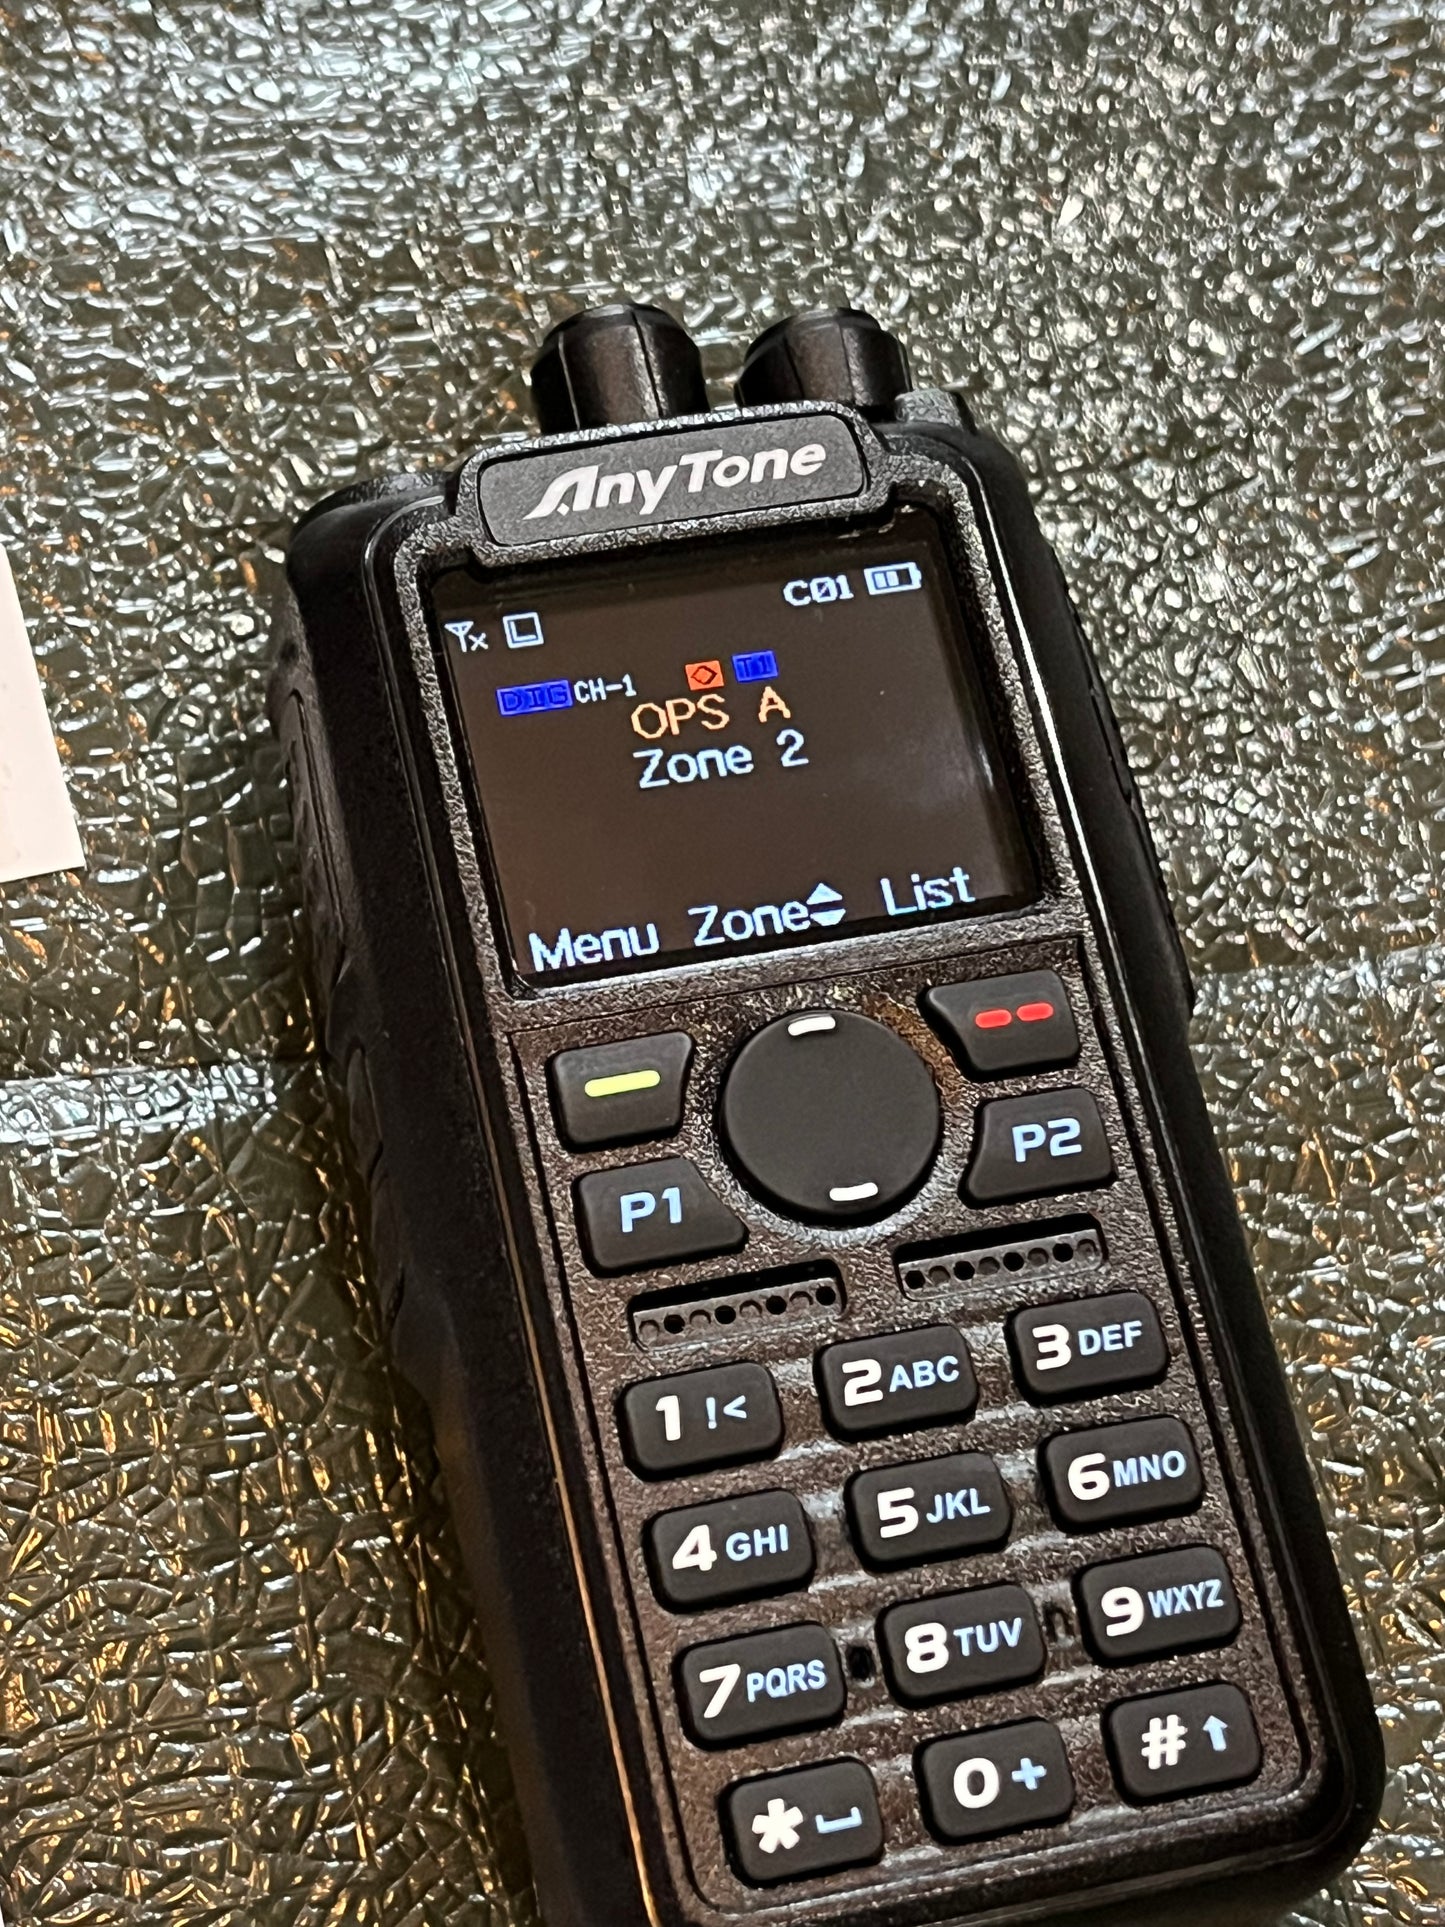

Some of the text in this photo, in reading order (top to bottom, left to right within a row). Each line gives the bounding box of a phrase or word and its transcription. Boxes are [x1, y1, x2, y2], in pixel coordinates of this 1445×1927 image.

[523, 442, 826, 520] AnyTone
[500, 676, 637, 712] DIG CH-1
[631, 687, 791, 739] OPS A
[633, 729, 809, 788] Zone 2
[528, 867, 975, 973] Menu Zone List
[1012, 1118, 1083, 1163] P2
[620, 1187, 684, 1233] P1
[1032, 1320, 1142, 1371] 3 DEF
[842, 1356, 960, 1406] 2 ABC
[655, 1395, 681, 1441] 1
[1067, 1450, 1187, 1501] 6 MNO
[877, 1487, 991, 1538] 5 JKL
[671, 1524, 789, 1571] 4 GHI
[1101, 1579, 1224, 1637] 9 WXYZ
[904, 1618, 1022, 1673] 8 TUV
[699, 1659, 827, 1719] 7 PQRS
[953, 1757, 999, 1808] 0
